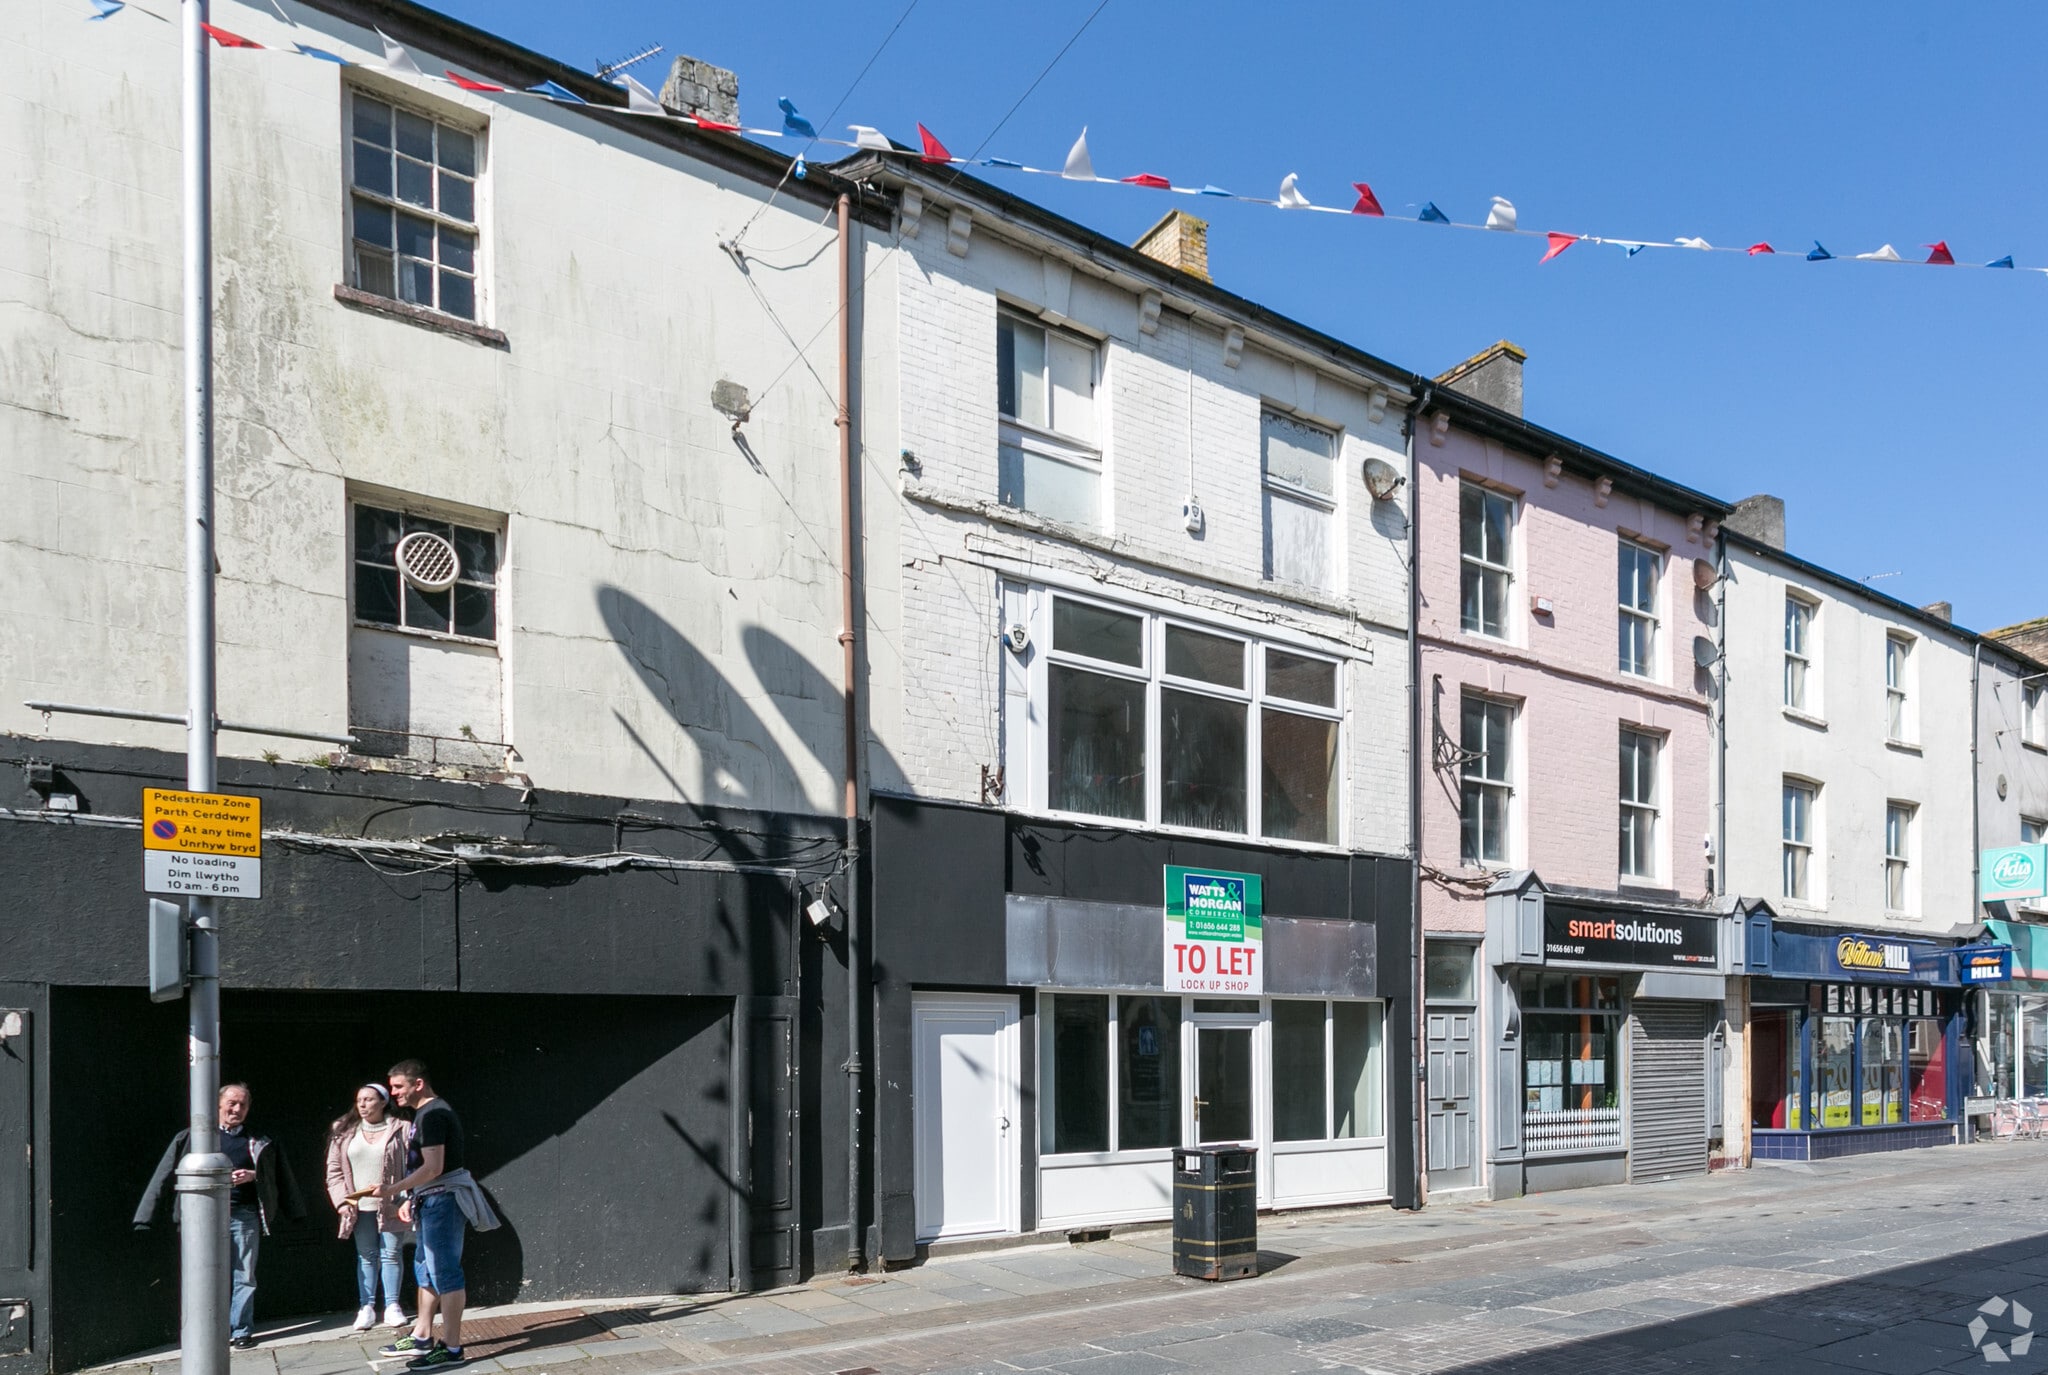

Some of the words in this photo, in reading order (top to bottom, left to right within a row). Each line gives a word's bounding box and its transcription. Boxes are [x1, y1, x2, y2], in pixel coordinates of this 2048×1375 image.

[154, 793, 219, 806] Pedestrian
[223, 798, 251, 809] Zone
[155, 806, 189, 817] Parth
[193, 810, 251, 823] Cerddwyr
[183, 825, 197, 834] At
[201, 829, 222, 837] any
[226, 830, 252, 839] time
[179, 839, 225, 851] Unrhyw
[230, 843, 256, 854] bryd
[171, 855, 189, 865] No
[193, 856, 237, 869] loading
[168, 869, 191, 879] Dim
[195, 870, 240, 882] llwytho
[167, 881, 182, 890] 10
[184, 882, 202, 891] am
[212, 883, 220, 892] 6
[222, 885, 240, 894] pm
[1188, 884, 1226, 898] WATTS
[1226, 881, 1241, 901] &
[1189, 896, 1242, 912] MORGAN
[1189, 909, 1240, 919] COMMERCIAL
[1568, 919, 1683, 945] smartsolutions
[1173, 944, 1206, 974] TO
[1216, 946, 1256, 976] LET
[1838, 938, 1885, 968] William
[1884, 945, 1911, 970] HILL
[1971, 966, 2003, 979] HILL
[1181, 979, 1206, 990] LOCK
[1209, 980, 1221, 990] UP
[1225, 981, 1249, 991] SHOP
